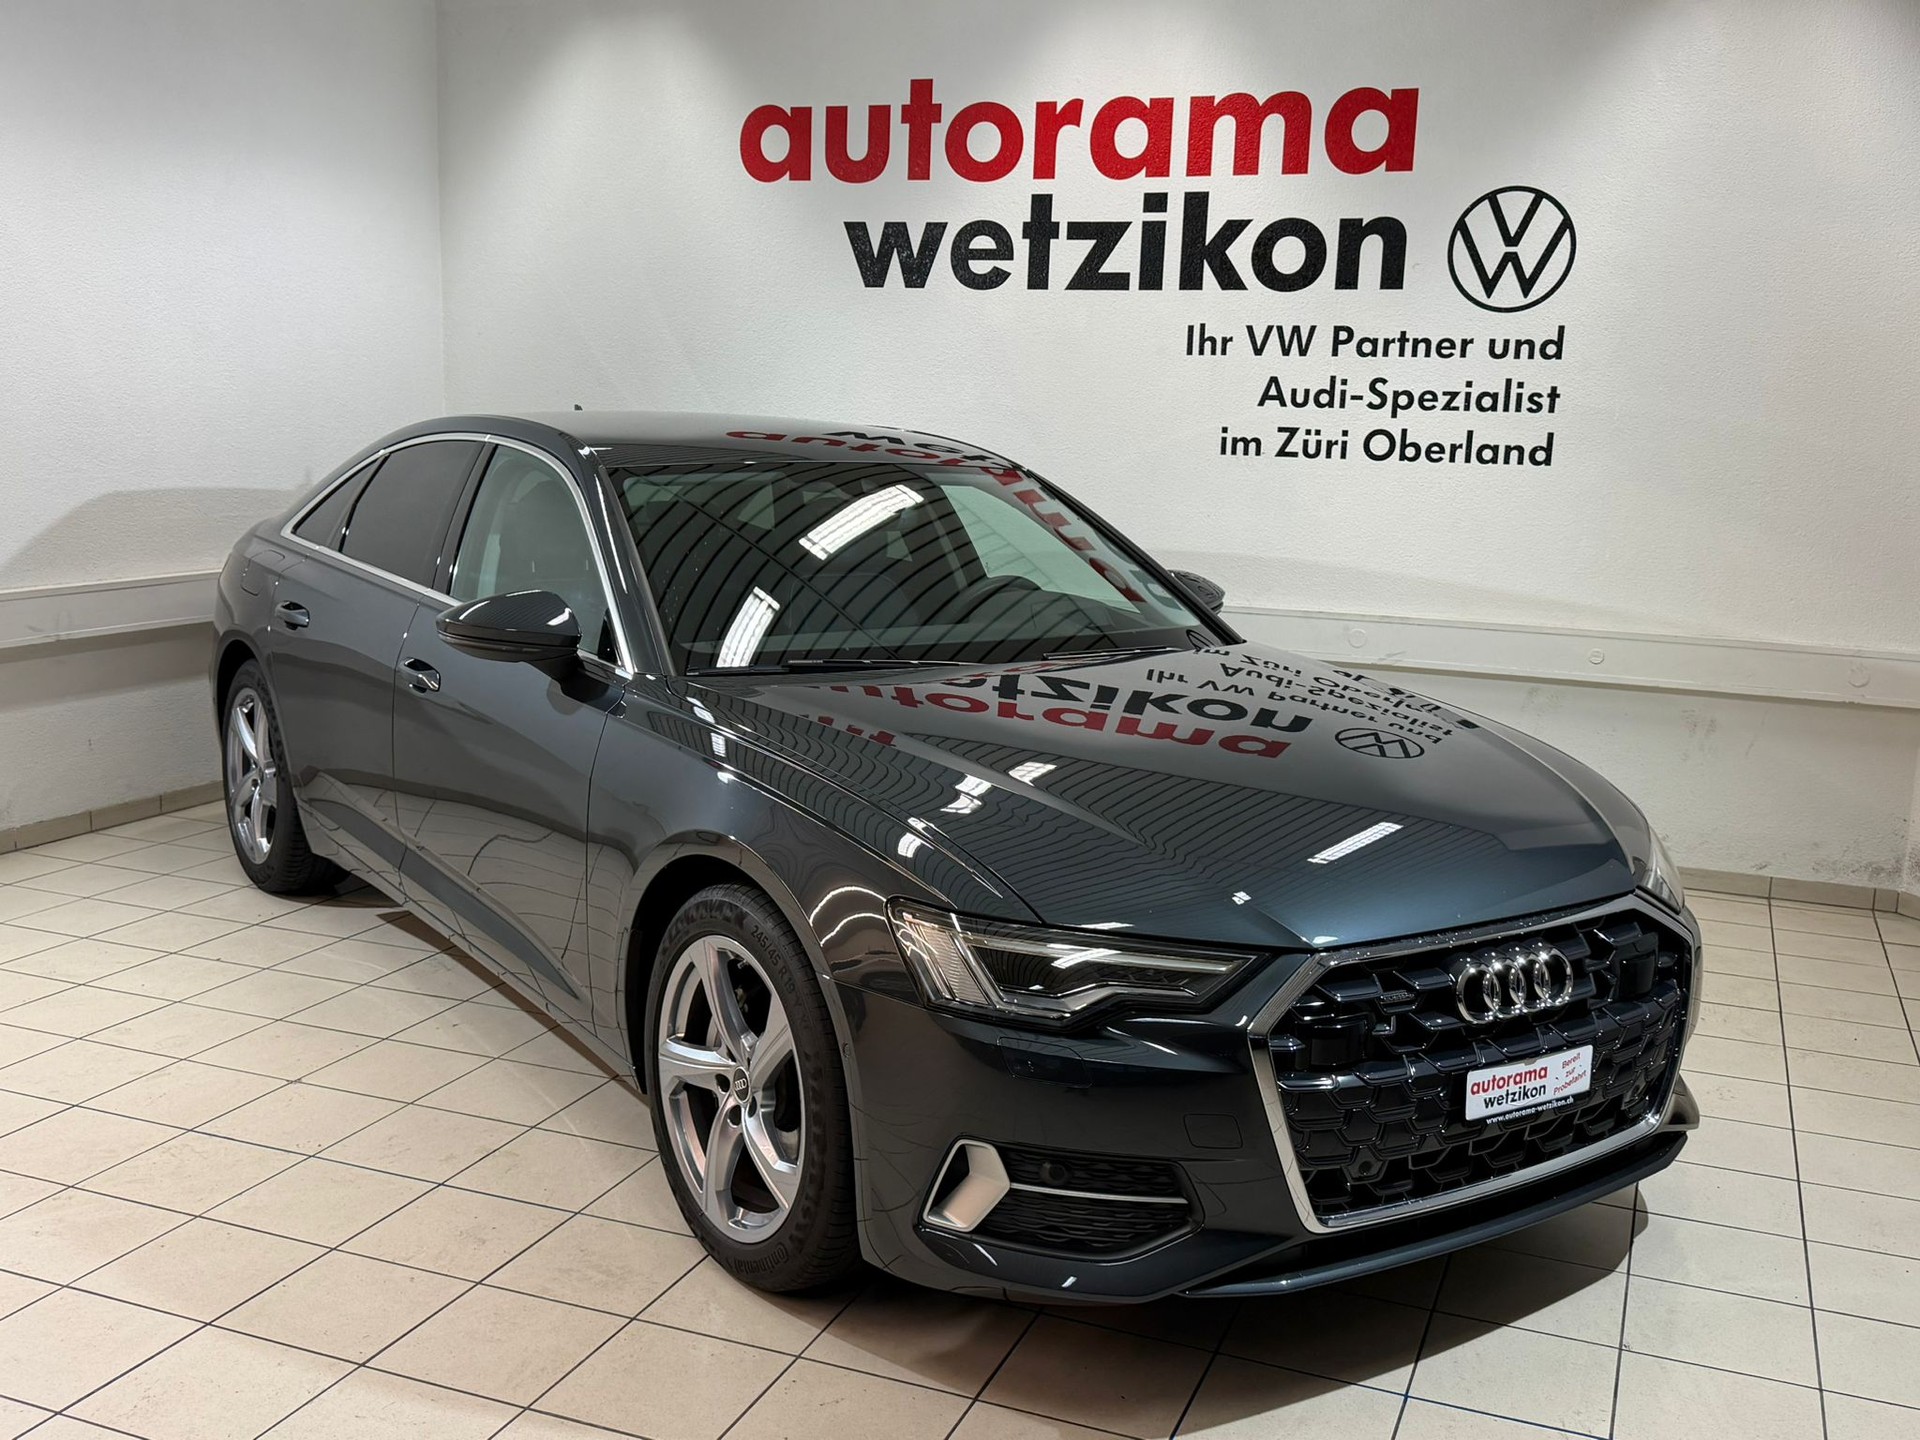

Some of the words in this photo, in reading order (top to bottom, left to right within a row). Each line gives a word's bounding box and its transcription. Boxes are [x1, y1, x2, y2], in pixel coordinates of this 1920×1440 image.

[740, 79, 1420, 184] autorama
[844, 192, 1409, 293] wetzikon
[1187, 324, 1235, 357] Ihr
[1246, 325, 1318, 358] VW
[1332, 326, 1475, 360] Partner
[1488, 326, 1567, 361] und
[1258, 376, 1562, 419] Audi-Spezialist
[1220, 427, 1263, 458] im
[1275, 427, 1350, 461] Züri
[1363, 429, 1556, 468] Oberland
[750, 924, 782, 967] 245/45
[1470, 1066, 1549, 1096] autorama
[1483, 1084, 1547, 1109] wetzikon
[1553, 1069, 1588, 1096] Probefahrt
[1486, 1095, 1574, 1125] www.autorama-wetzikon.ch
